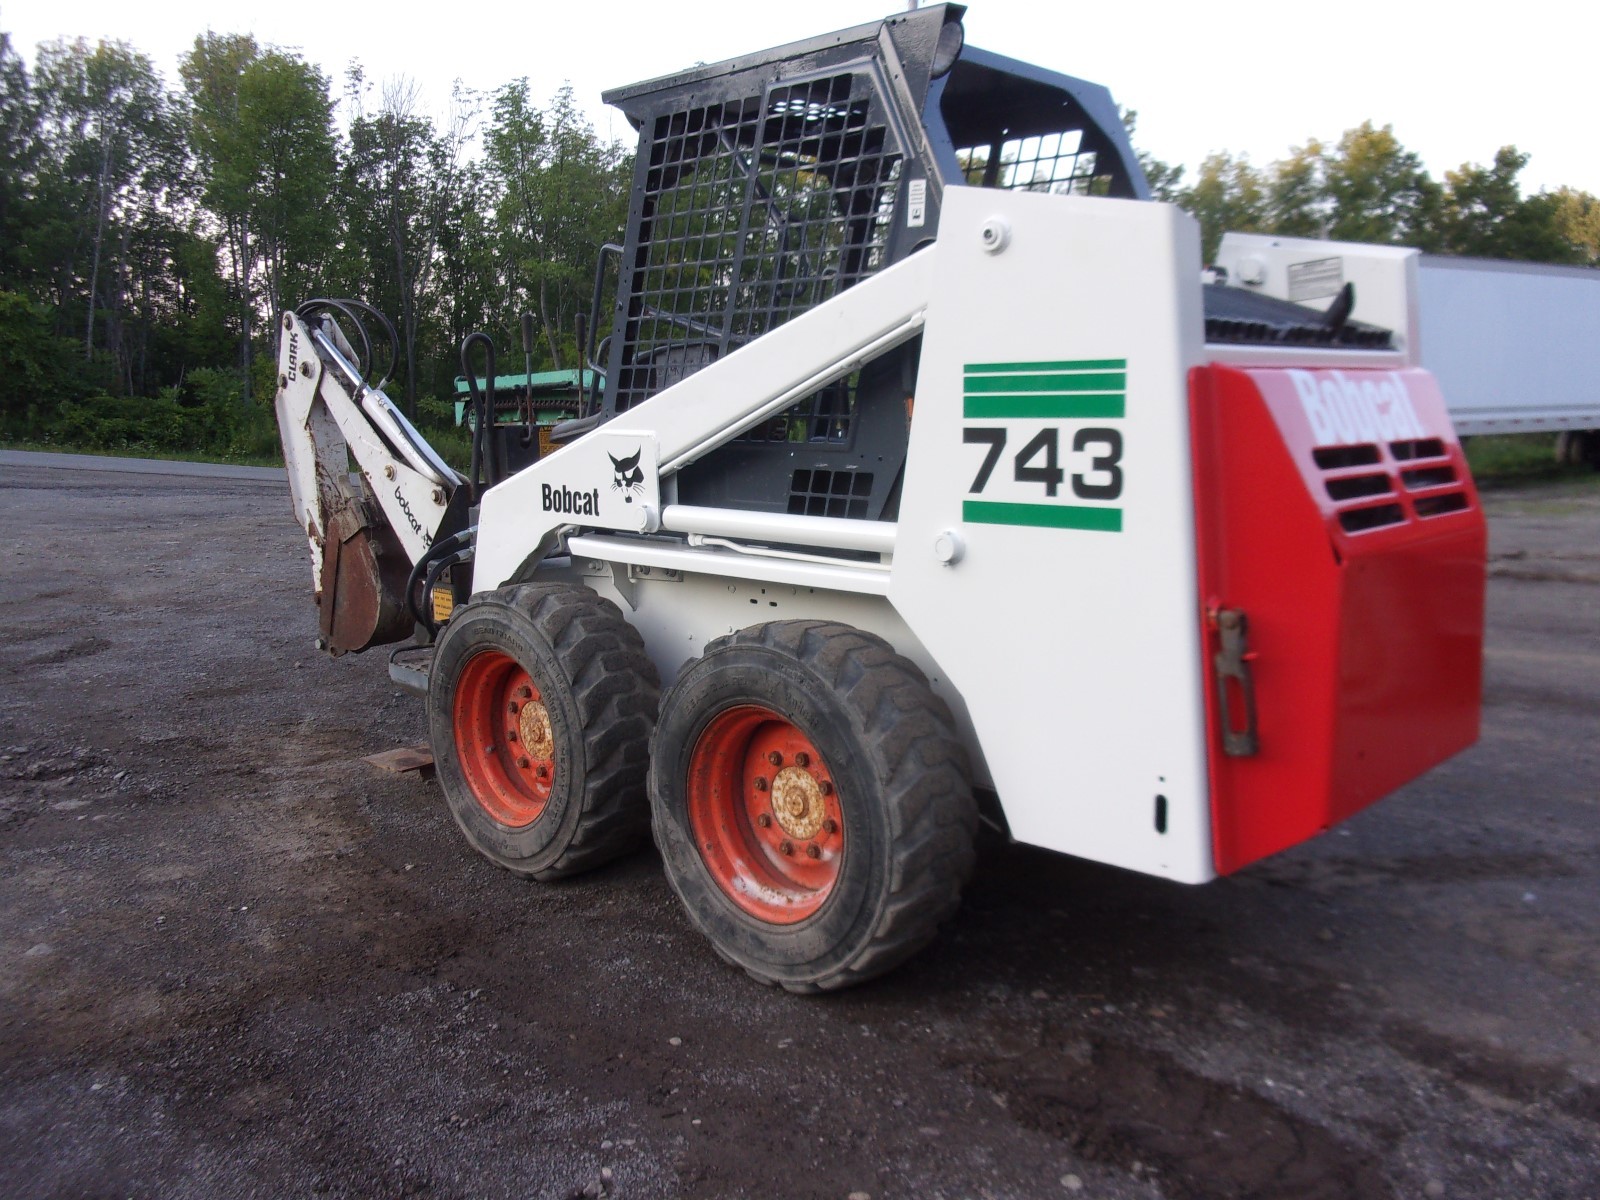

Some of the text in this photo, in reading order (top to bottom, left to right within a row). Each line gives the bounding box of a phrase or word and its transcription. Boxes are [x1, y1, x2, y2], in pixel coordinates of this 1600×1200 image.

[288, 332, 298, 382] CLARK
[1288, 369, 1428, 446] Bobcat
[963, 427, 1123, 500] 743
[395, 485, 422, 535] bobcat
[541, 483, 600, 516] Bobcat
